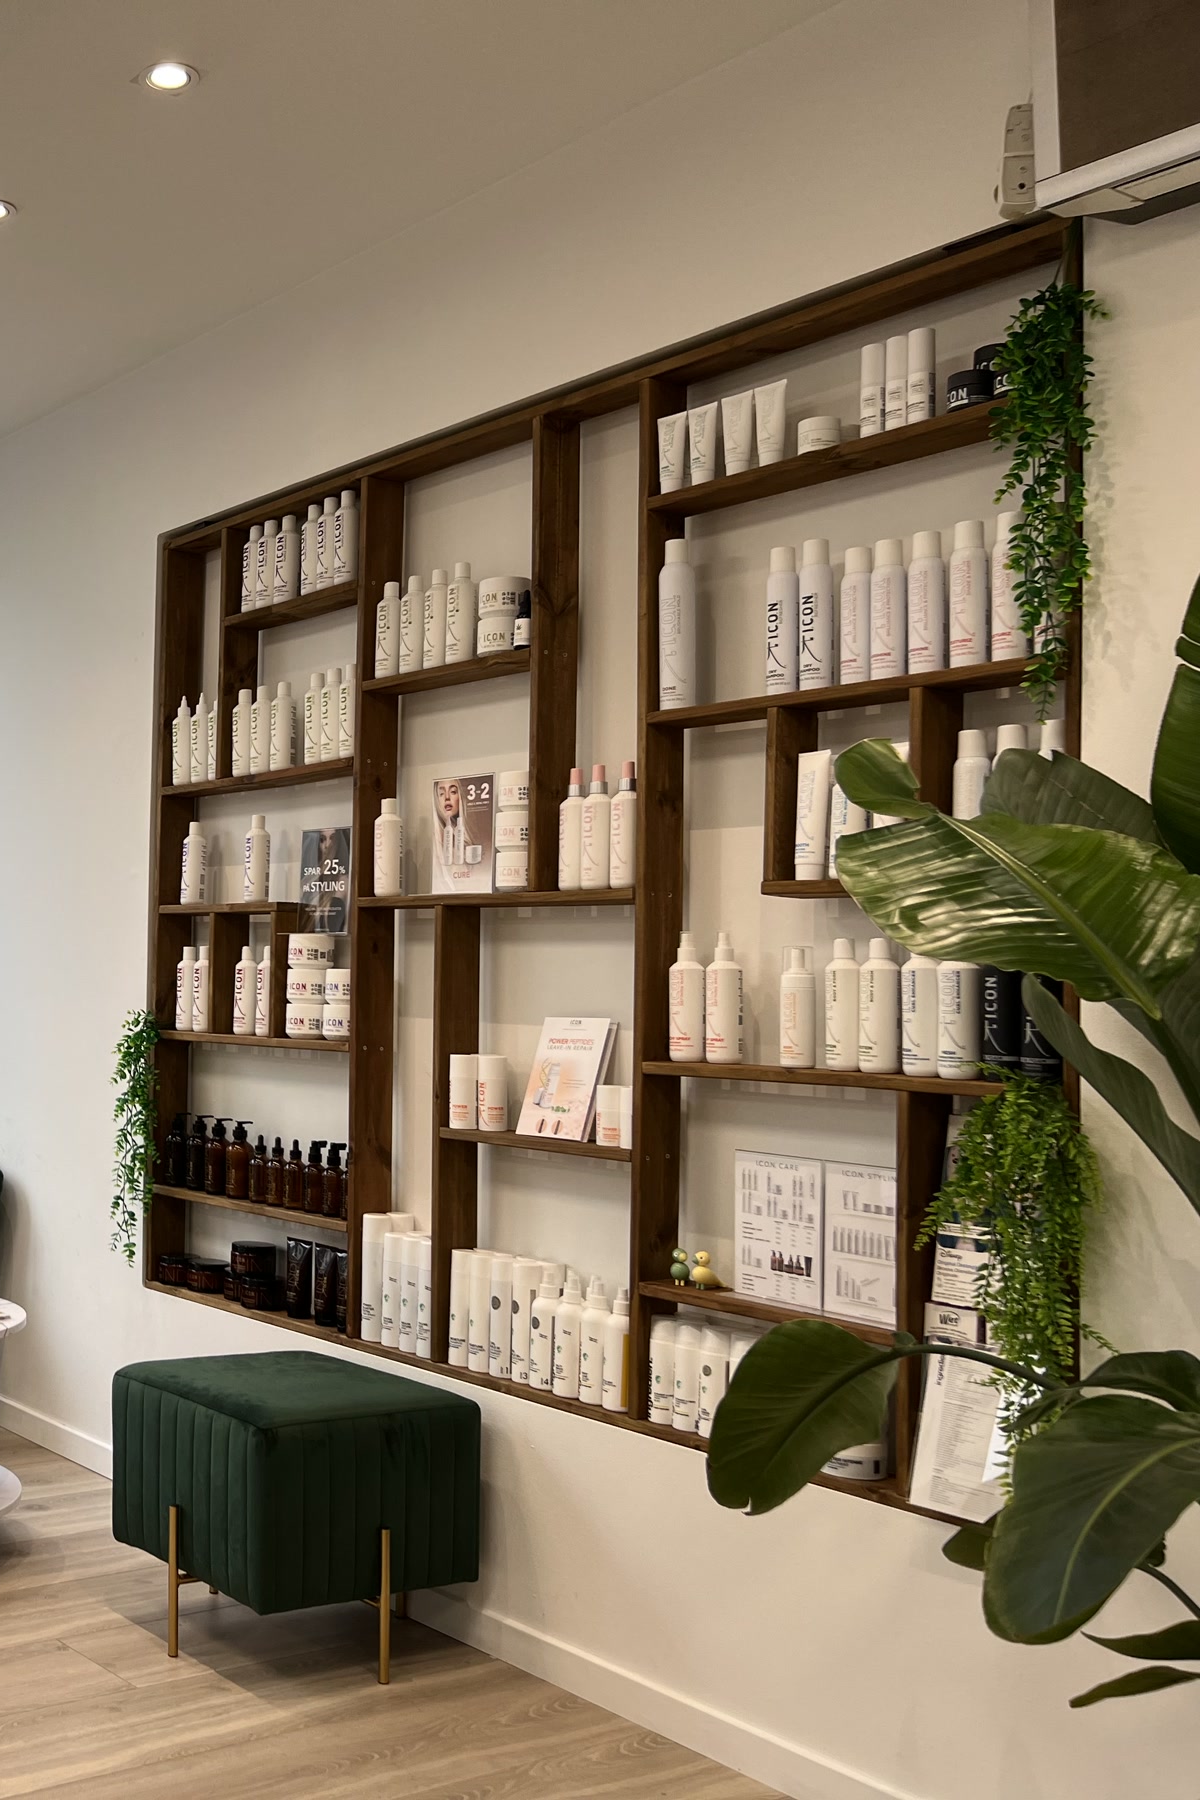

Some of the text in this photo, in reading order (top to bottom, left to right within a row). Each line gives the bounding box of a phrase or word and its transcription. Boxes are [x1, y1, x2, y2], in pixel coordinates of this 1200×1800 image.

[303, 859, 346, 876] SPAR 25%
[453, 870, 471, 879] CURE
[310, 880, 345, 892] STYLING
[570, 1038, 595, 1046] PEPTIDES
[779, 1163, 799, 1172] CARE
[867, 1173, 897, 1182] STYLIN
